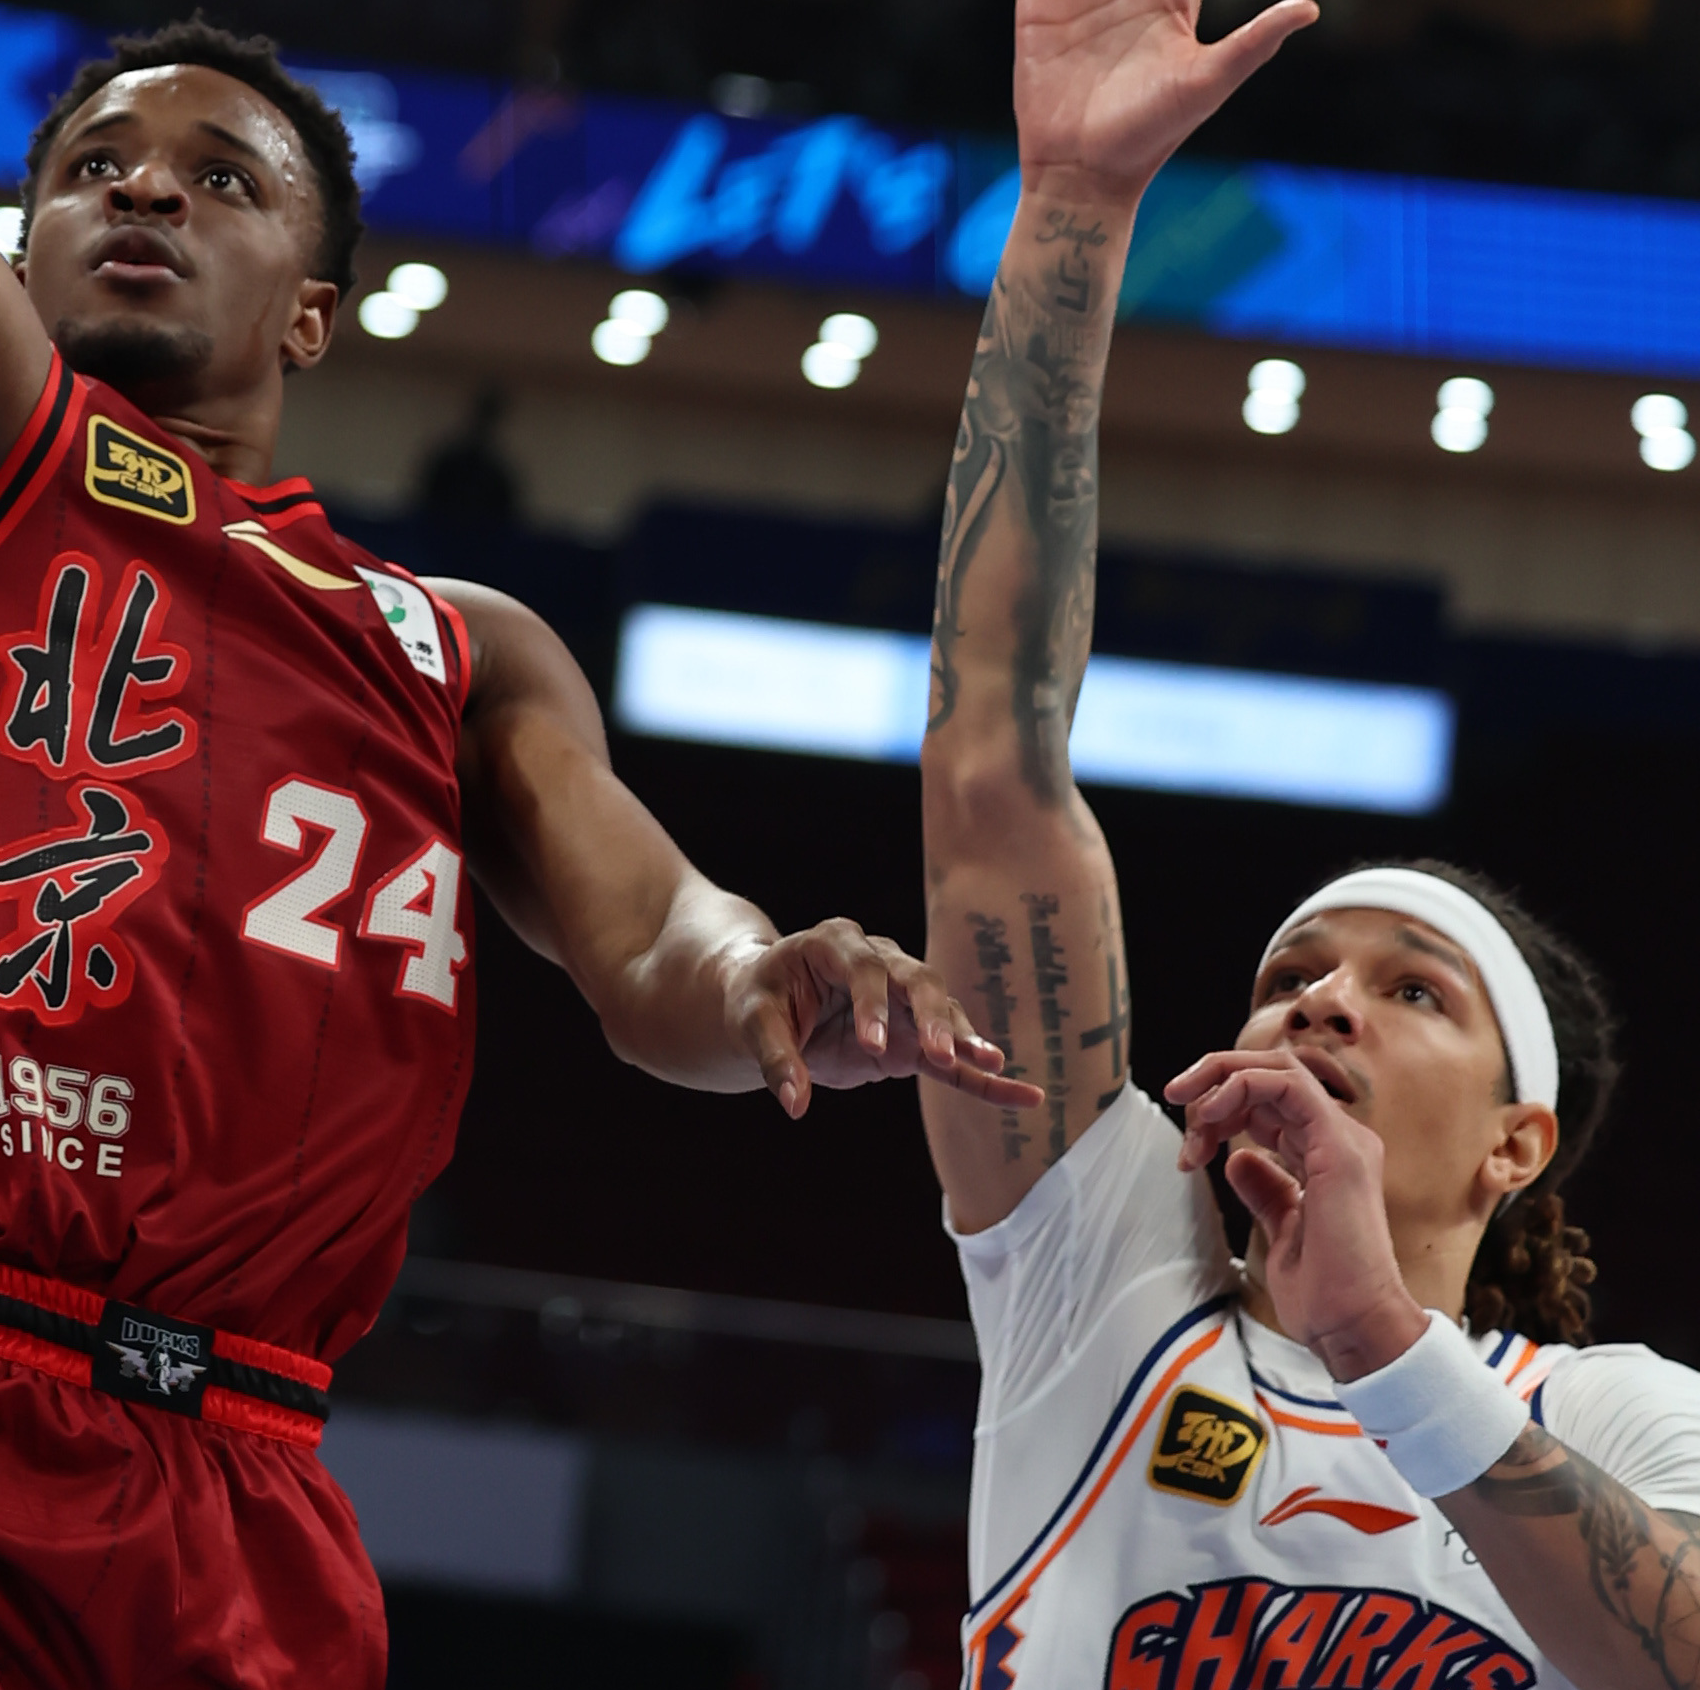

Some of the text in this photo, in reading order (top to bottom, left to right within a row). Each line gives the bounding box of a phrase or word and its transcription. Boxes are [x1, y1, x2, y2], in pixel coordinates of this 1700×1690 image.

[240, 773, 469, 1016] 24
[0, 1119, 125, 1178] SINCE
[121, 1316, 201, 1358] DUCKS
